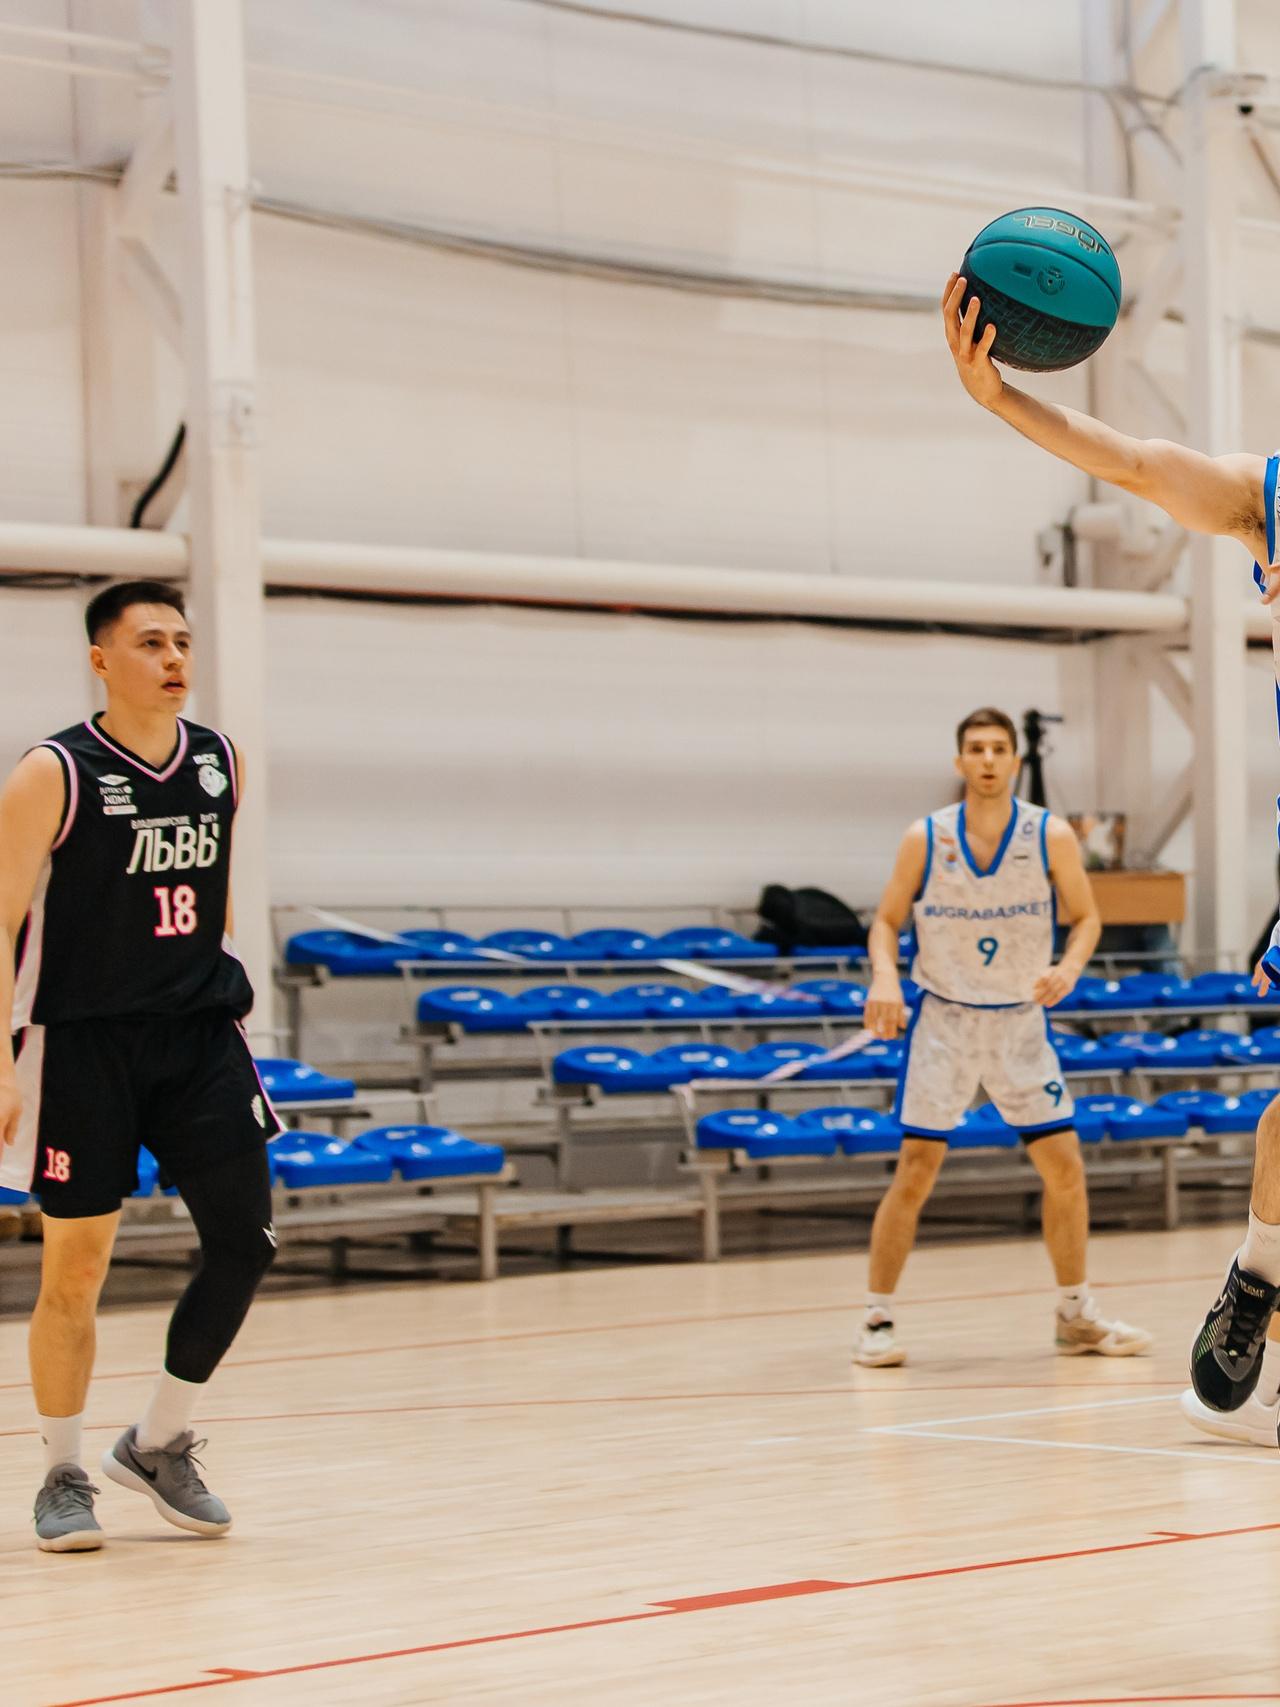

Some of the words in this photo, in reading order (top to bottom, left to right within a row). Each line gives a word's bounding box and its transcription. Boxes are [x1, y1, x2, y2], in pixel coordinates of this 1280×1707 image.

[126, 823, 221, 875] ЛЬВЫ
[154, 884, 198, 938] 18
[976, 936, 998, 967] 9
[1043, 1081, 1065, 1108] 9
[43, 1146, 71, 1183] 18
